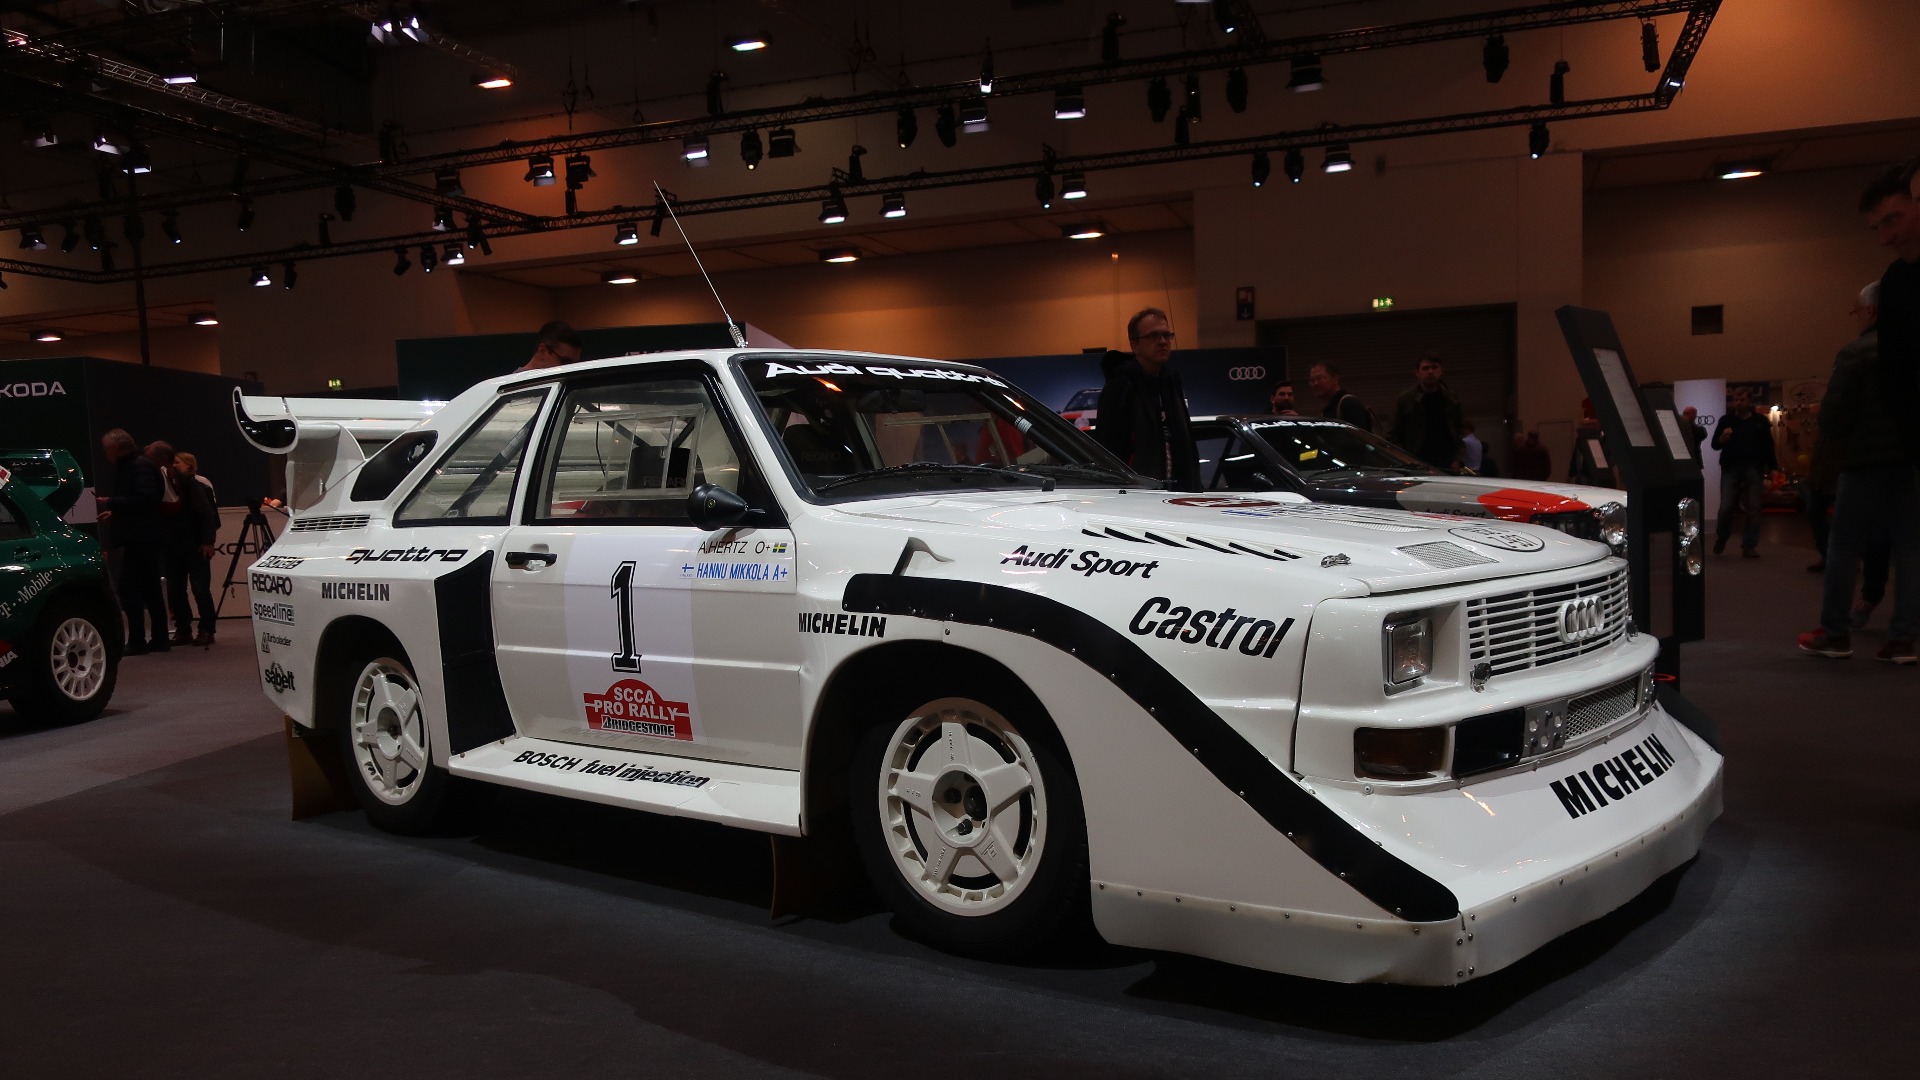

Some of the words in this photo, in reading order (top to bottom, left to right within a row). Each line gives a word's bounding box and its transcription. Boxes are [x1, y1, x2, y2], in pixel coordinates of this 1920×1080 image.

[765, 362, 863, 378] Audi
[345, 546, 469, 565] quattro
[1000, 544, 1074, 569] Audi
[1071, 550, 1160, 579] Sport
[696, 563, 728, 579] HANNU
[729, 563, 769, 580] MIKKOLA
[252, 571, 293, 597] RECARO
[321, 582, 390, 602] MICHELIN
[253, 602, 294, 622] speedline
[610, 560, 642, 674] 1
[798, 612, 887, 638] MICHELIN
[1128, 596, 1296, 659] Castrol
[613, 686, 656, 704] SCCA
[594, 700, 624, 715] PRO
[629, 703, 679, 722] RALLY
[601, 715, 675, 737] BRIDGESTONE
[513, 750, 583, 771] BOSCH
[578, 759, 628, 777] fuel
[616, 763, 711, 788] injection
[1548, 732, 1676, 820] MICHELIN
